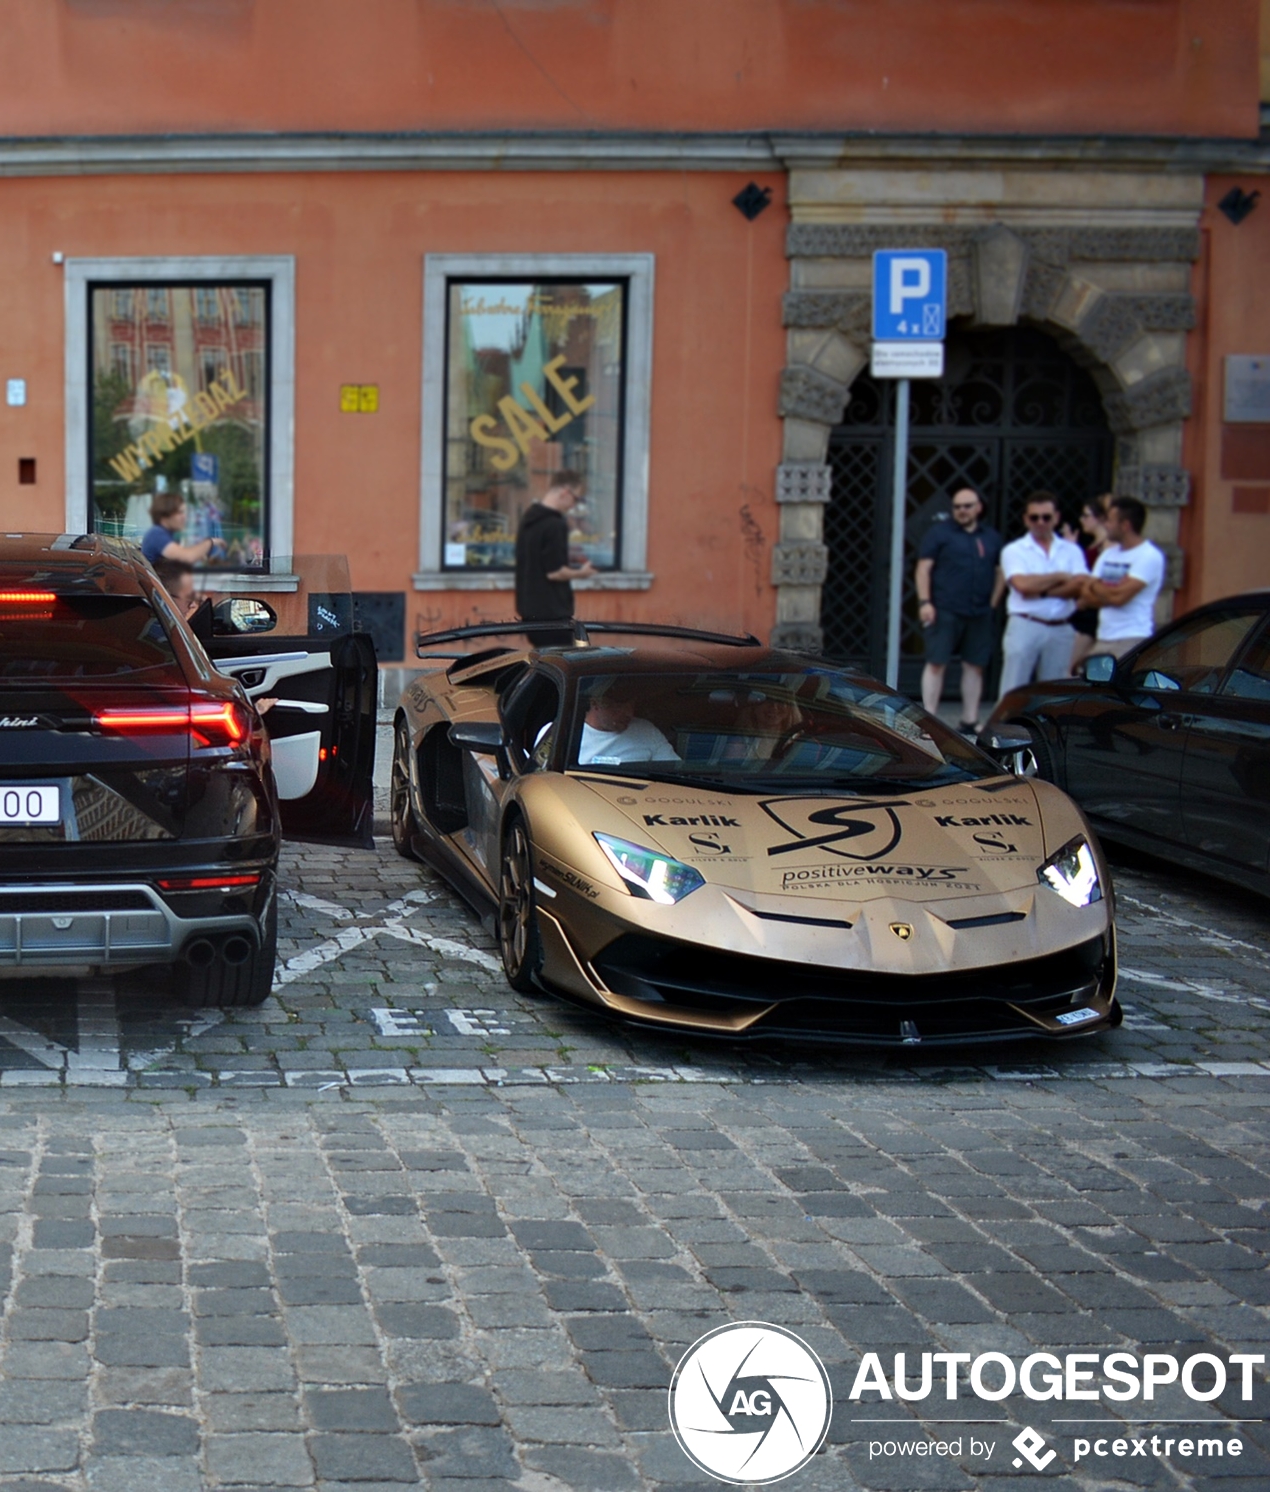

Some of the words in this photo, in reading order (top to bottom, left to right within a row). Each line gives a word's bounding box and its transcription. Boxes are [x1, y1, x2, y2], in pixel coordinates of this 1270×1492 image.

[890, 258, 930, 314] P
[469, 353, 596, 471] SALE
[642, 814, 742, 828] Karlik
[933, 814, 1033, 827] Karlik
[782, 864, 970, 886] positiveways
